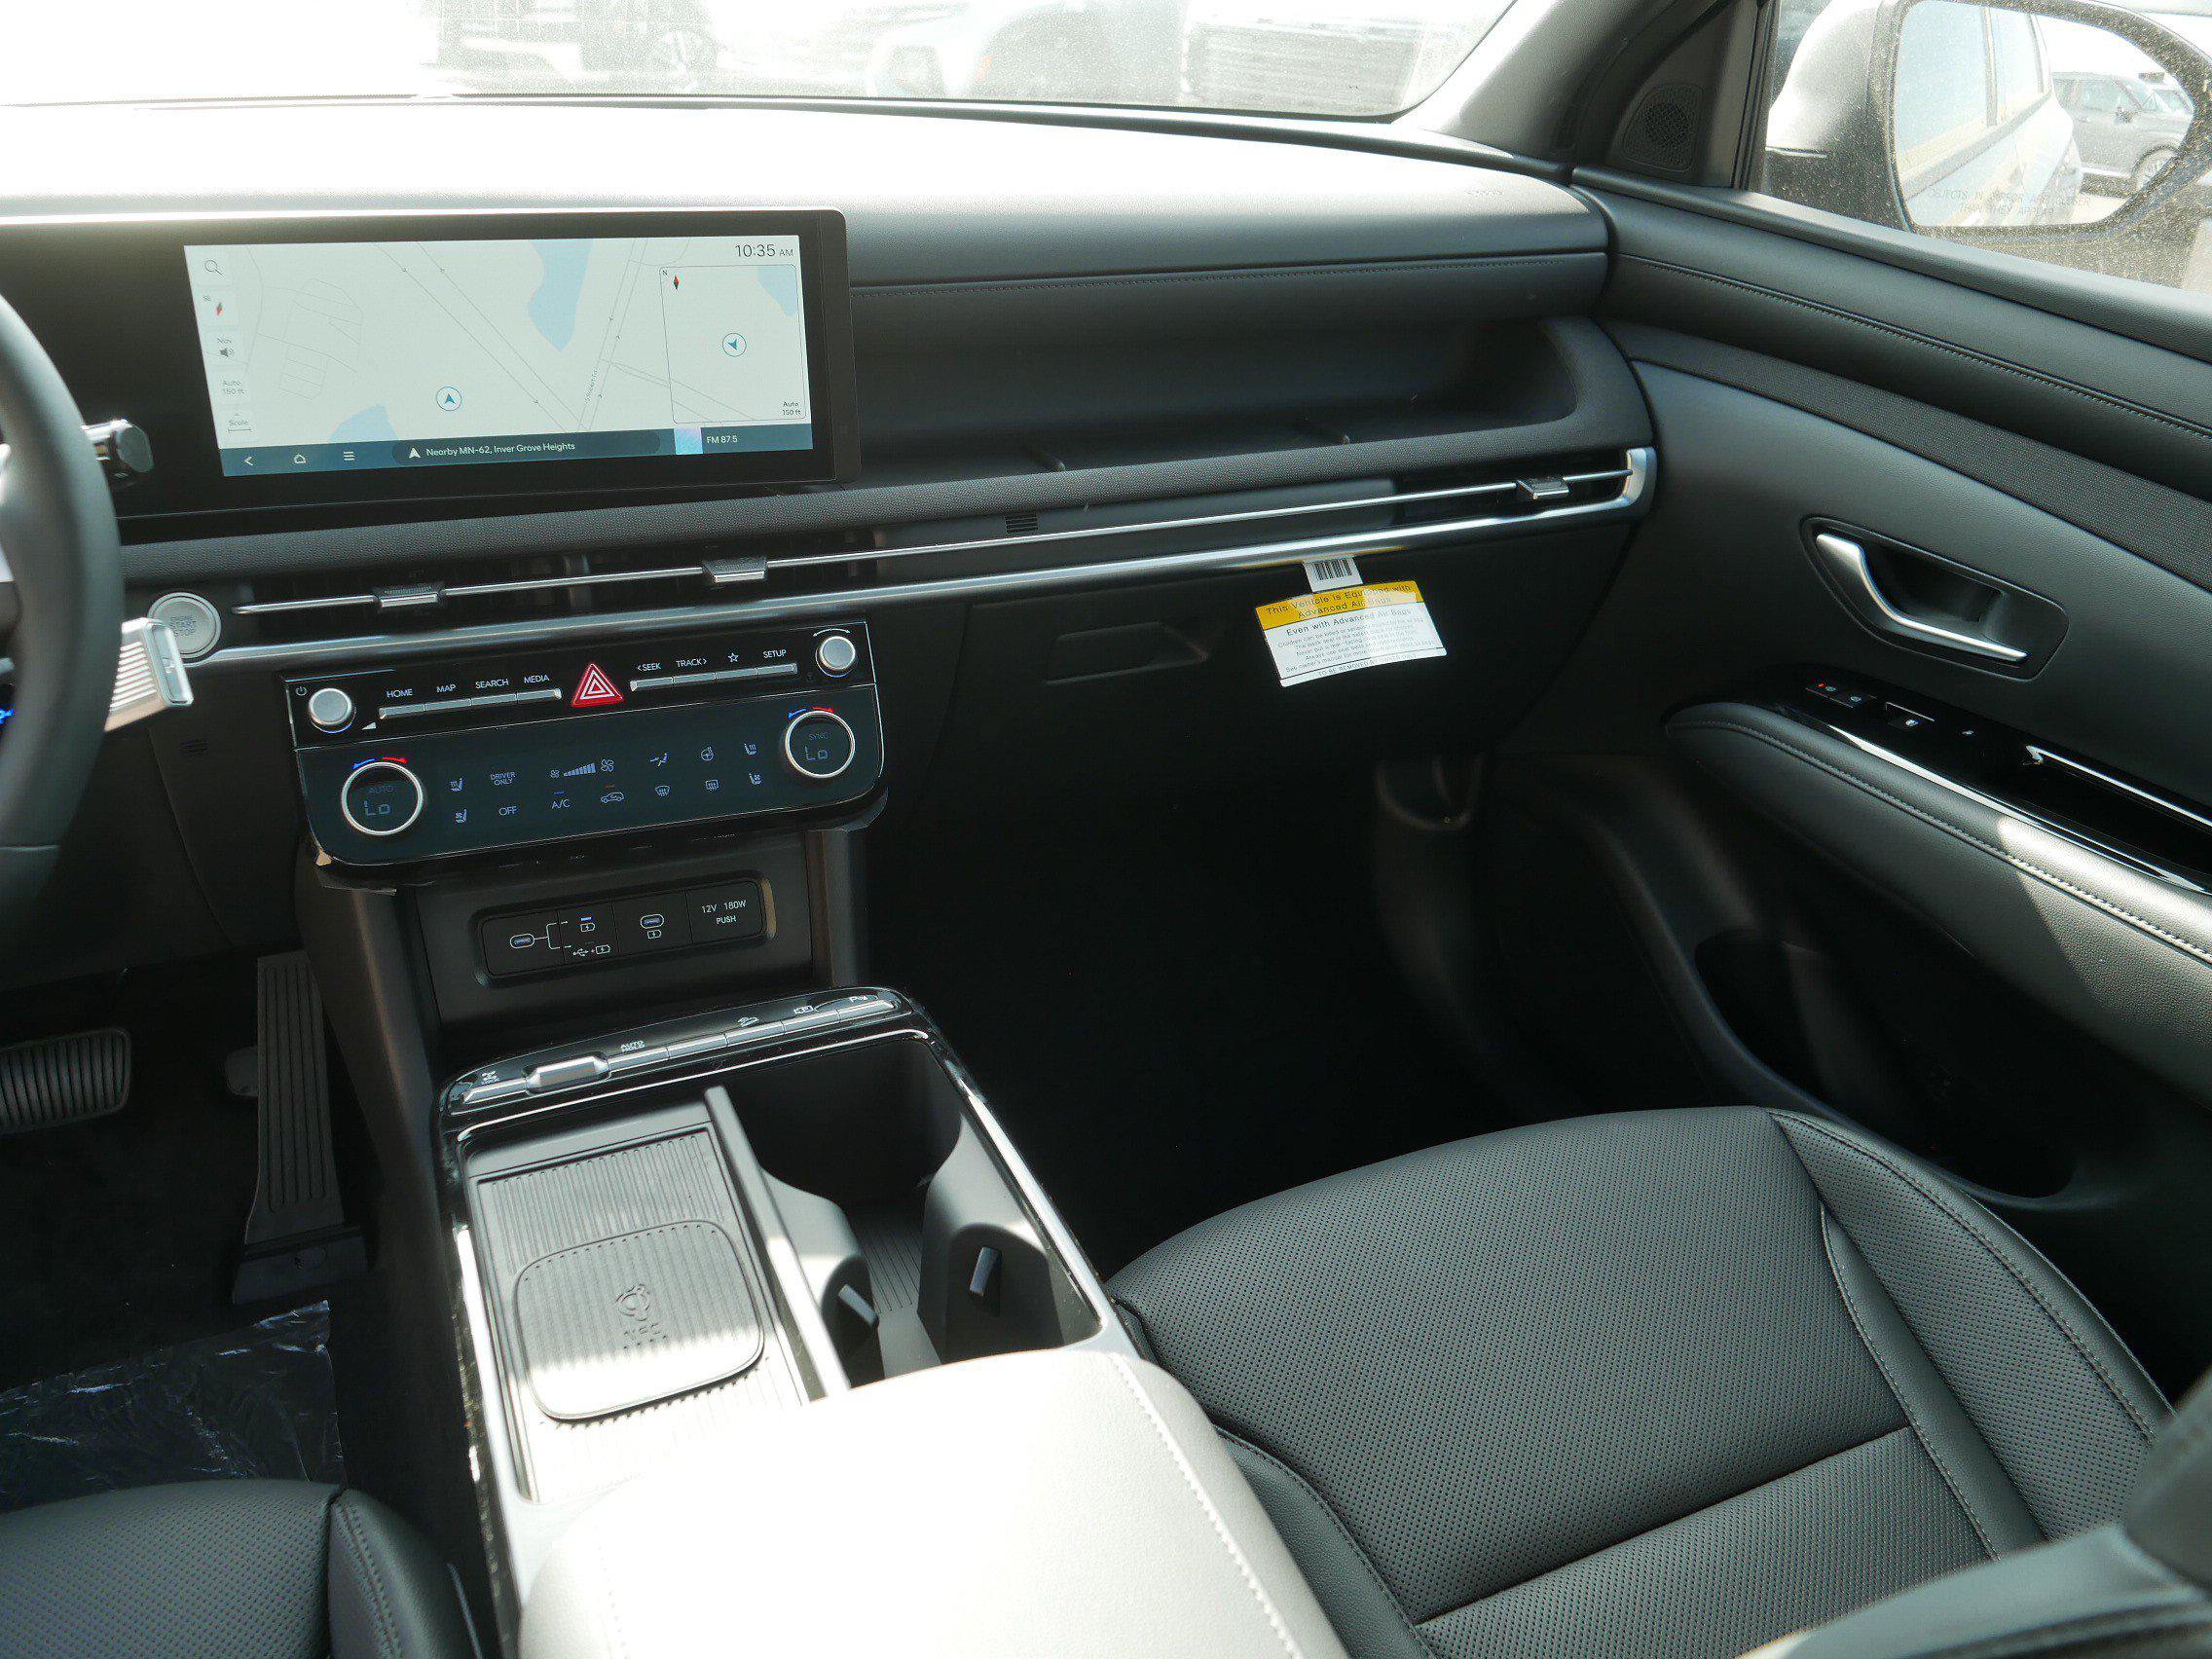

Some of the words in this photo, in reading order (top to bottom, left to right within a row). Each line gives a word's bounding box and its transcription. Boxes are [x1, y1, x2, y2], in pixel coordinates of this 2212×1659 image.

[734, 243, 776, 257] 10:35
[779, 248, 793, 257] AM
[425, 448, 458, 458] Nearby
[460, 446, 493, 456] MN-62,
[494, 445, 515, 454] Inver
[543, 442, 575, 452] Heights
[1266, 605, 1289, 615] This
[1291, 595, 1330, 610] Vehicle
[1392, 583, 1411, 592] with
[1297, 602, 1347, 619] Advanced
[1286, 625, 1309, 637] Even
[1312, 621, 1331, 630] with
[1332, 612, 1375, 626] Advanced
[763, 649, 787, 659] SETUP
[475, 678, 509, 689] SEARCH
[524, 674, 550, 684] MEDIA
[387, 687, 413, 698] HOME
[436, 683, 456, 693] MAP
[490, 771, 516, 781] DRIVER
[494, 777, 514, 787] ONLY
[551, 798, 571, 810] A/C
[498, 806, 518, 816] OFF
[701, 904, 718, 914] 12V
[723, 900, 747, 911] 180W
[716, 915, 737, 925] PUSH
